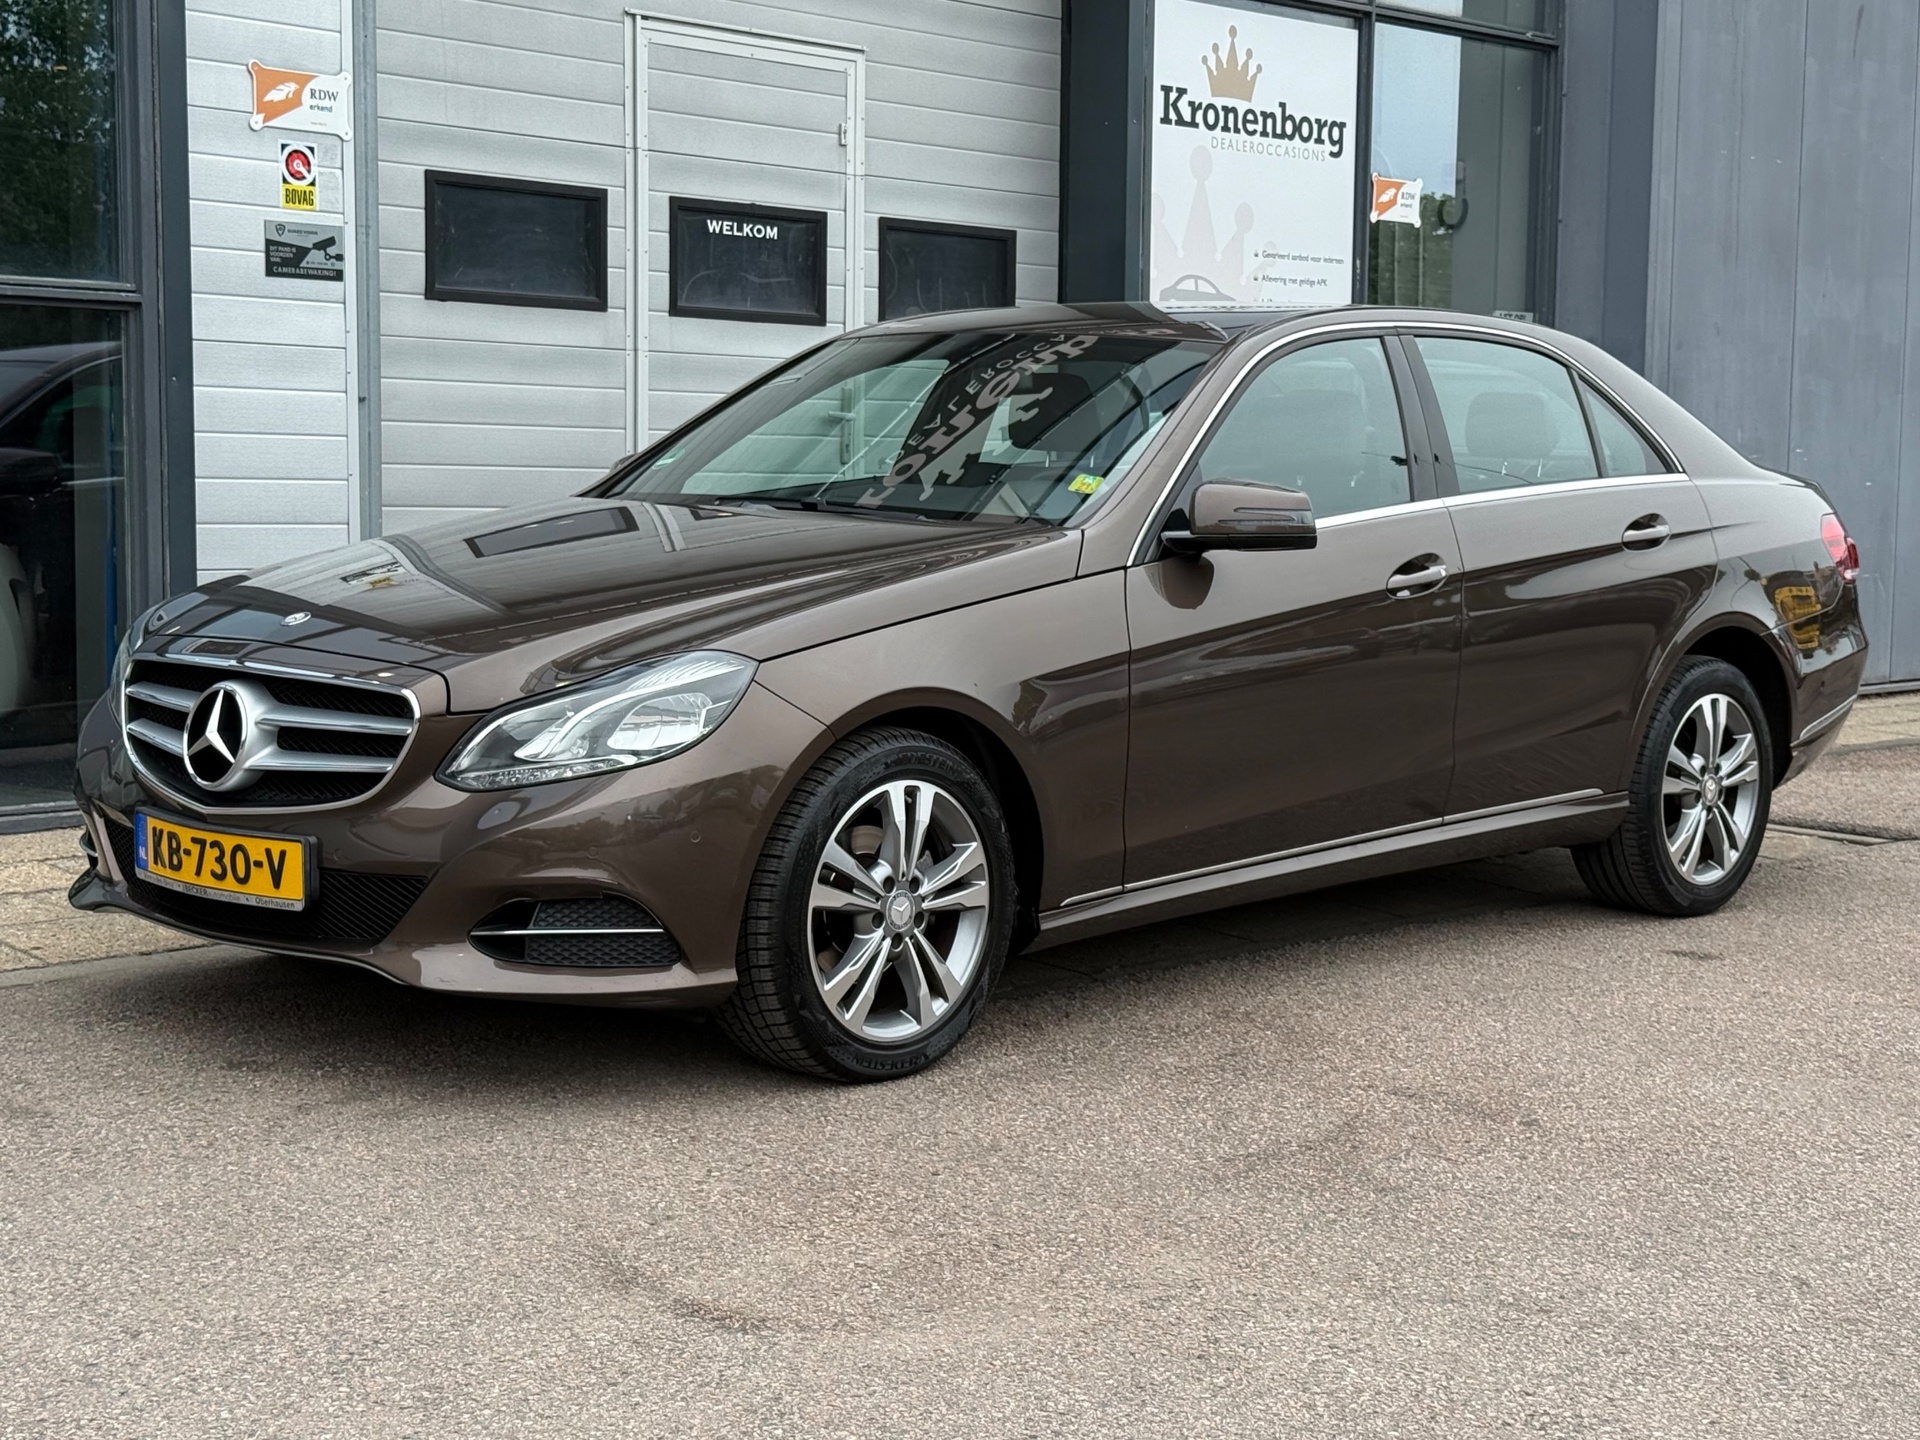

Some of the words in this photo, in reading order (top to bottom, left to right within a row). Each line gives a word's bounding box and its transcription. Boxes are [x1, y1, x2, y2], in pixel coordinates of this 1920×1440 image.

[310, 88, 339, 102] RDW
[309, 103, 333, 113] erkend
[1160, 85, 1347, 158] Kronenborg
[1211, 136, 1326, 162] DEALEROCCASIONS
[285, 188, 314, 207] BOVAG
[1401, 191, 1416, 200] RDW
[706, 219, 779, 240] WELKOM
[152, 826, 287, 890] KB-730-V
